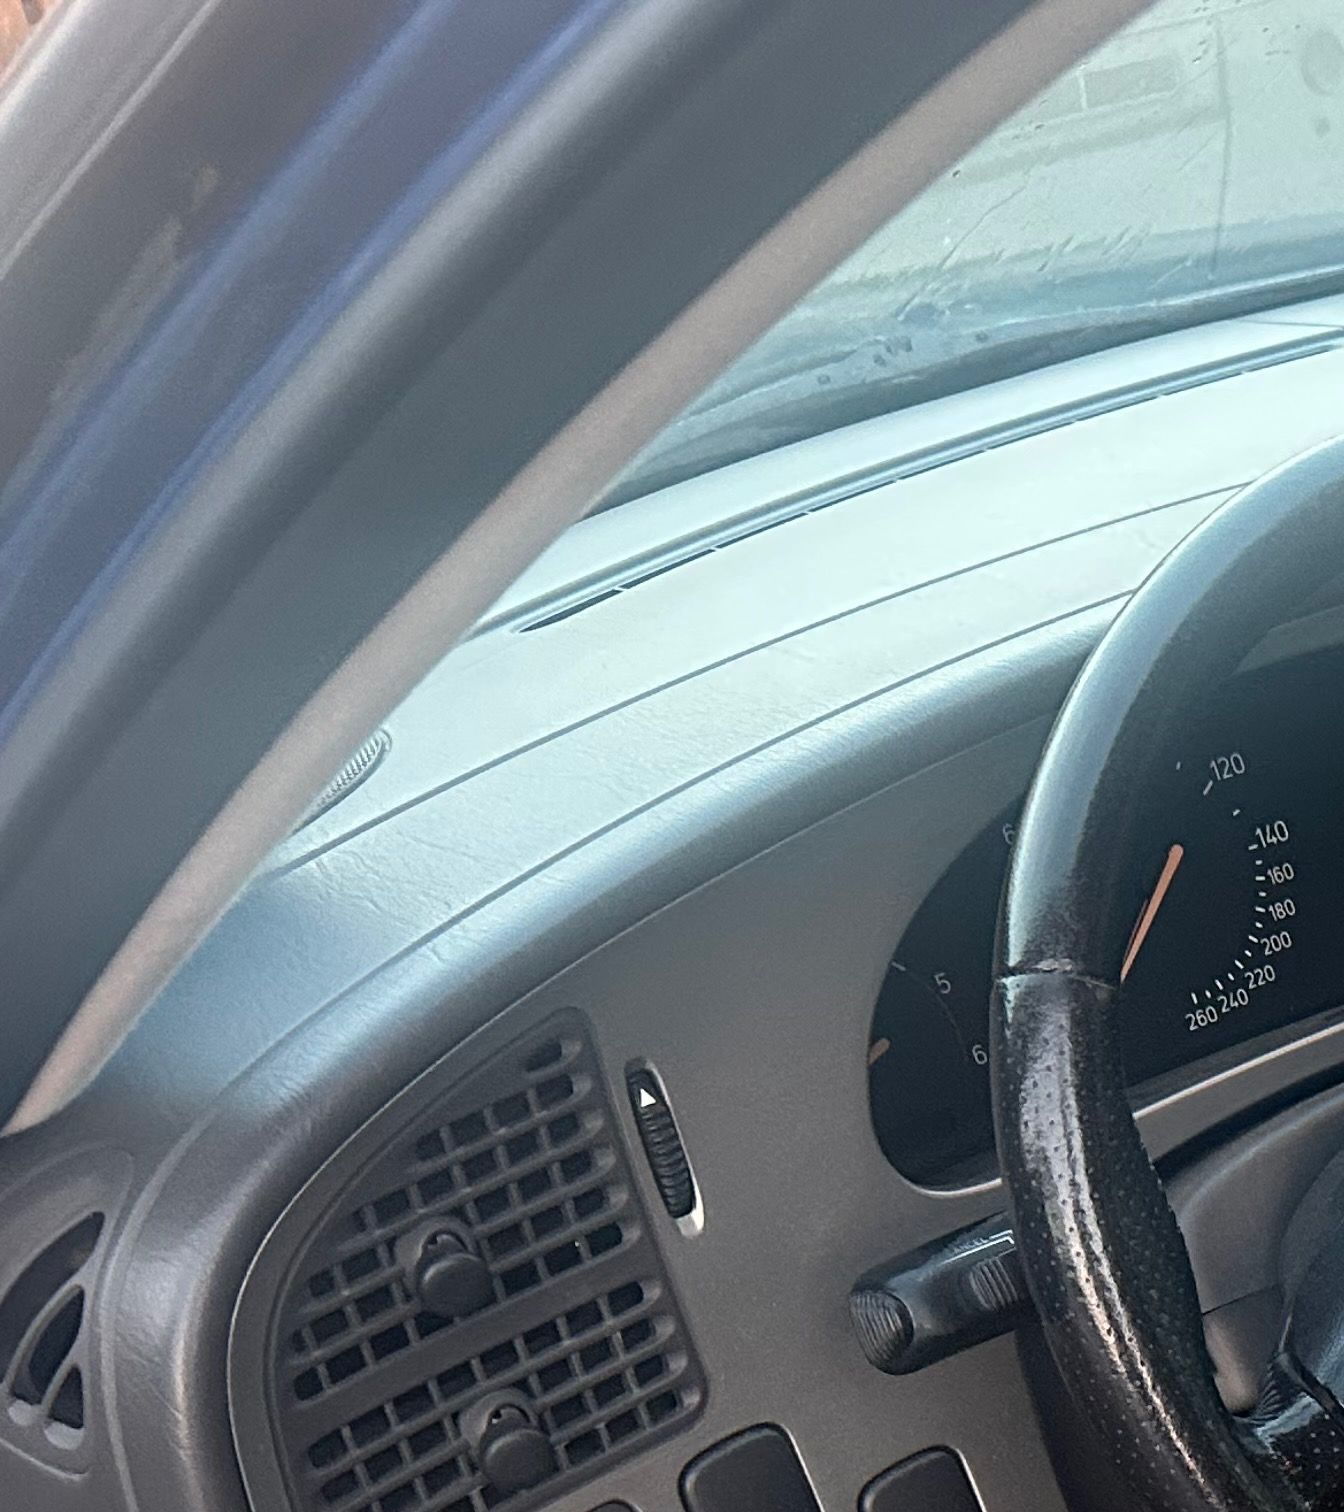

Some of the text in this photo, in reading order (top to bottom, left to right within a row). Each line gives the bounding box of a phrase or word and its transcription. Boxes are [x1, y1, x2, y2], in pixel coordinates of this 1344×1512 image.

[1209, 751, 1247, 782] 120
[1255, 820, 1290, 849] 140
[1266, 862, 1295, 887] 160
[1268, 898, 1297, 923] 180
[1260, 930, 1293, 957] 200
[932, 972, 952, 995] 5
[1244, 964, 1277, 991] 220
[1217, 988, 1250, 1014] 240
[1184, 1005, 1220, 1032] 260
[971, 1044, 989, 1066] 6
